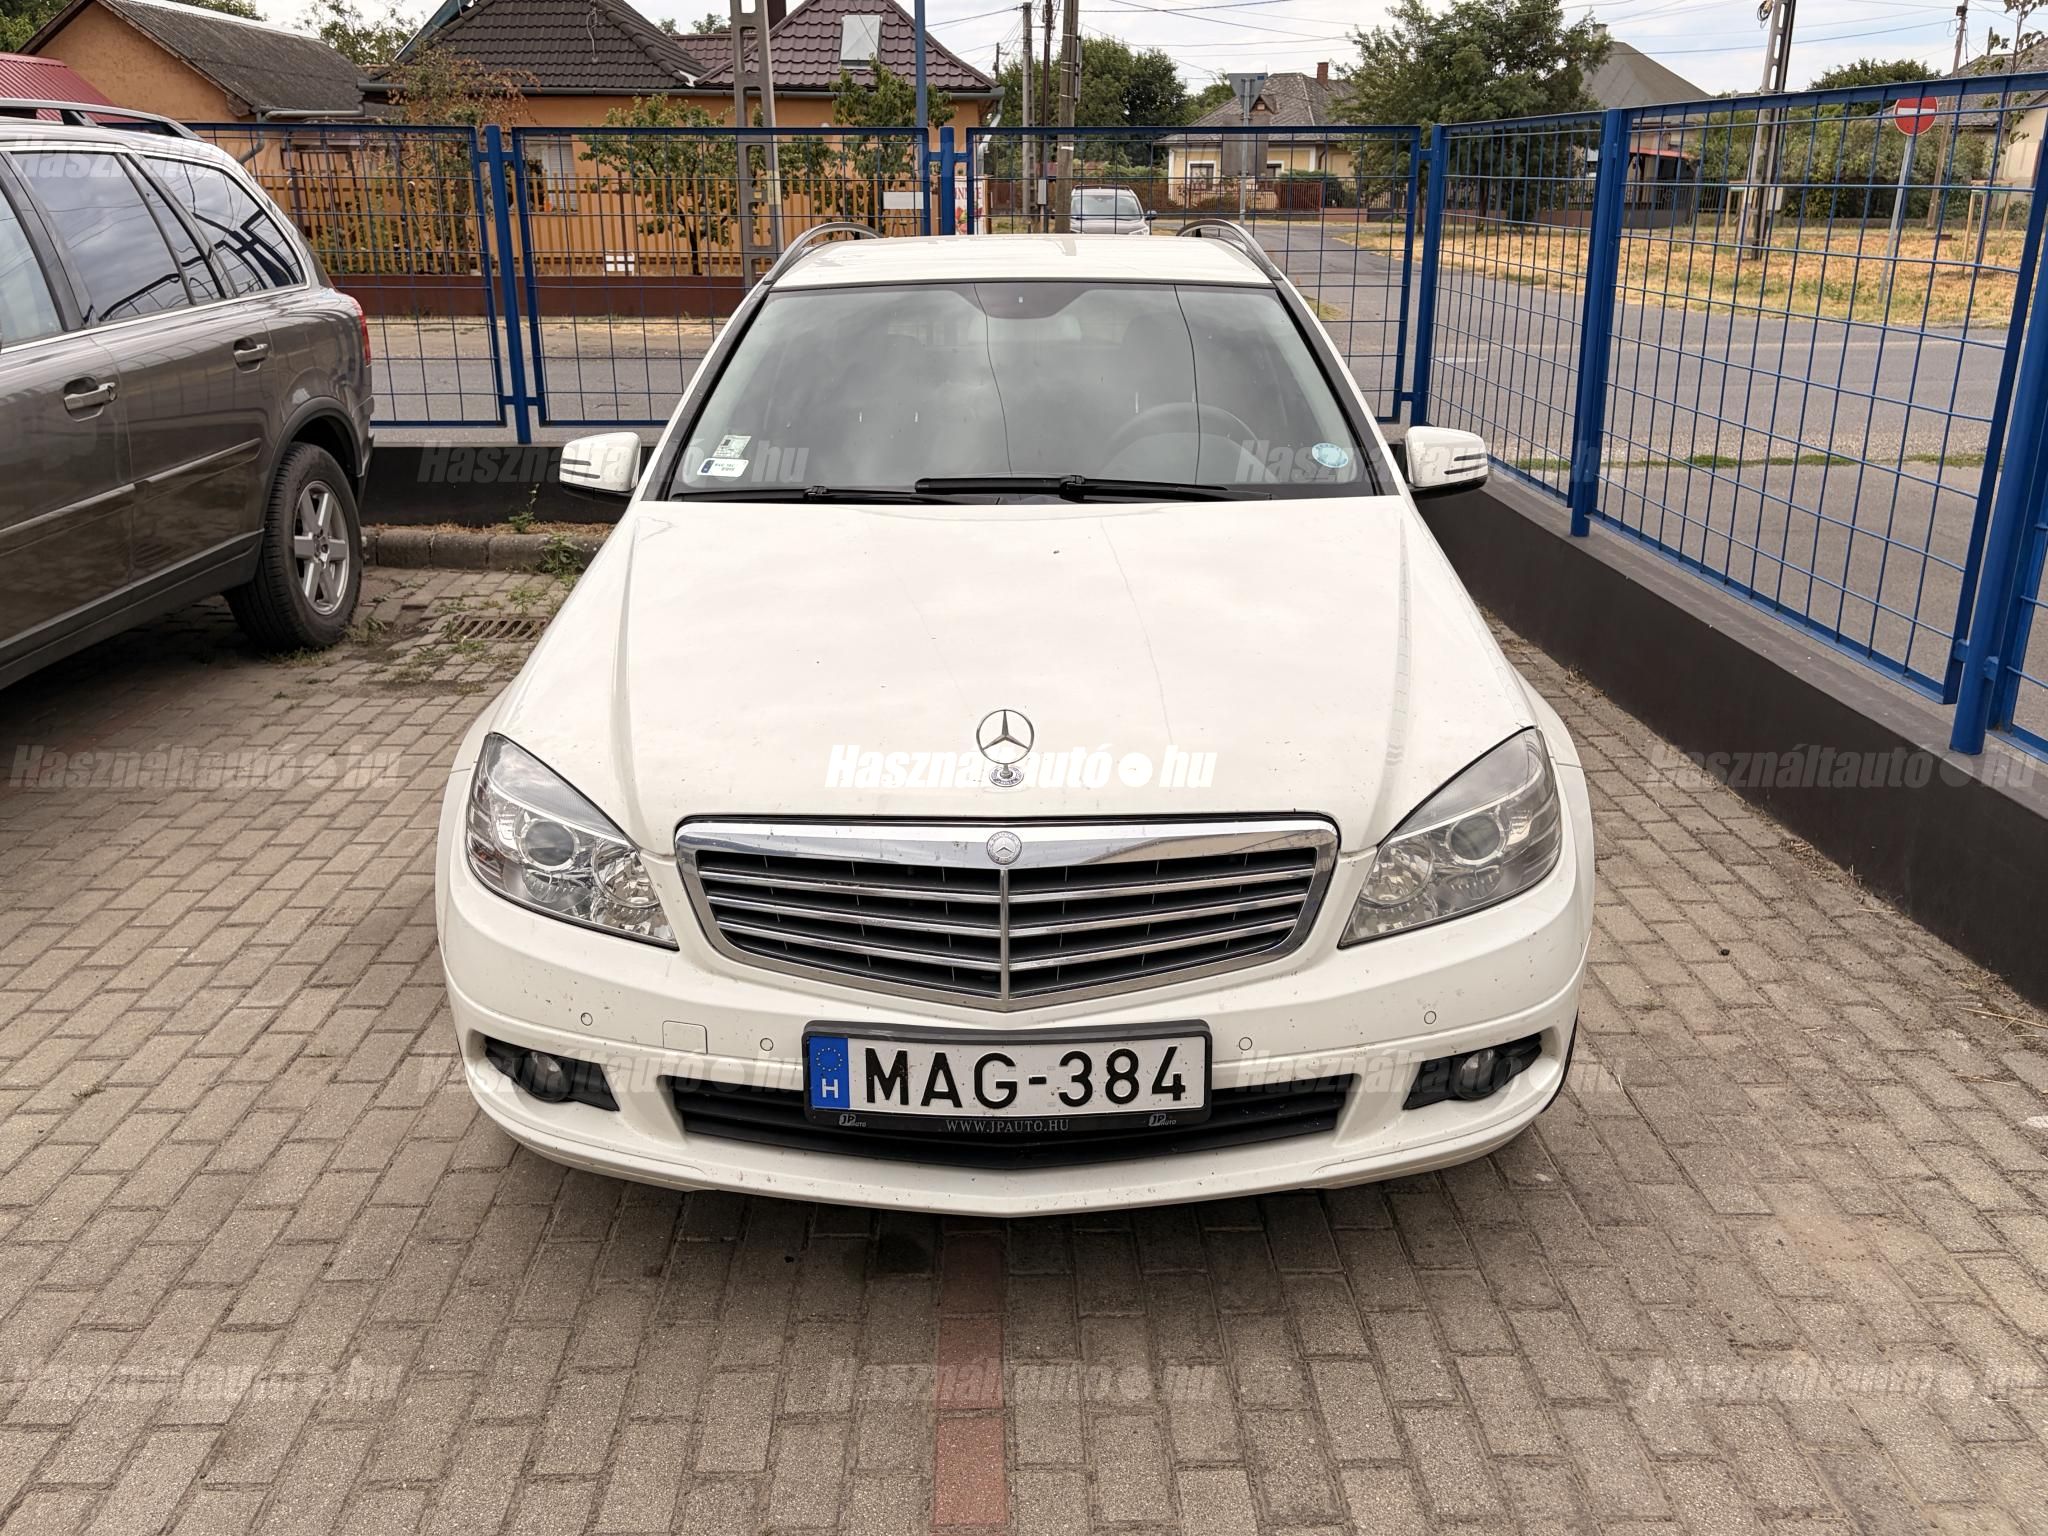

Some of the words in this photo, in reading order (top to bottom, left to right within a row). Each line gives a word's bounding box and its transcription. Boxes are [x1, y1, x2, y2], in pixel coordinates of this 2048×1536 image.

[821, 1078, 840, 1099] H
[864, 1046, 1187, 1108] MAG-384
[945, 1119, 1069, 1133] WWW.JPAUTO.HU
